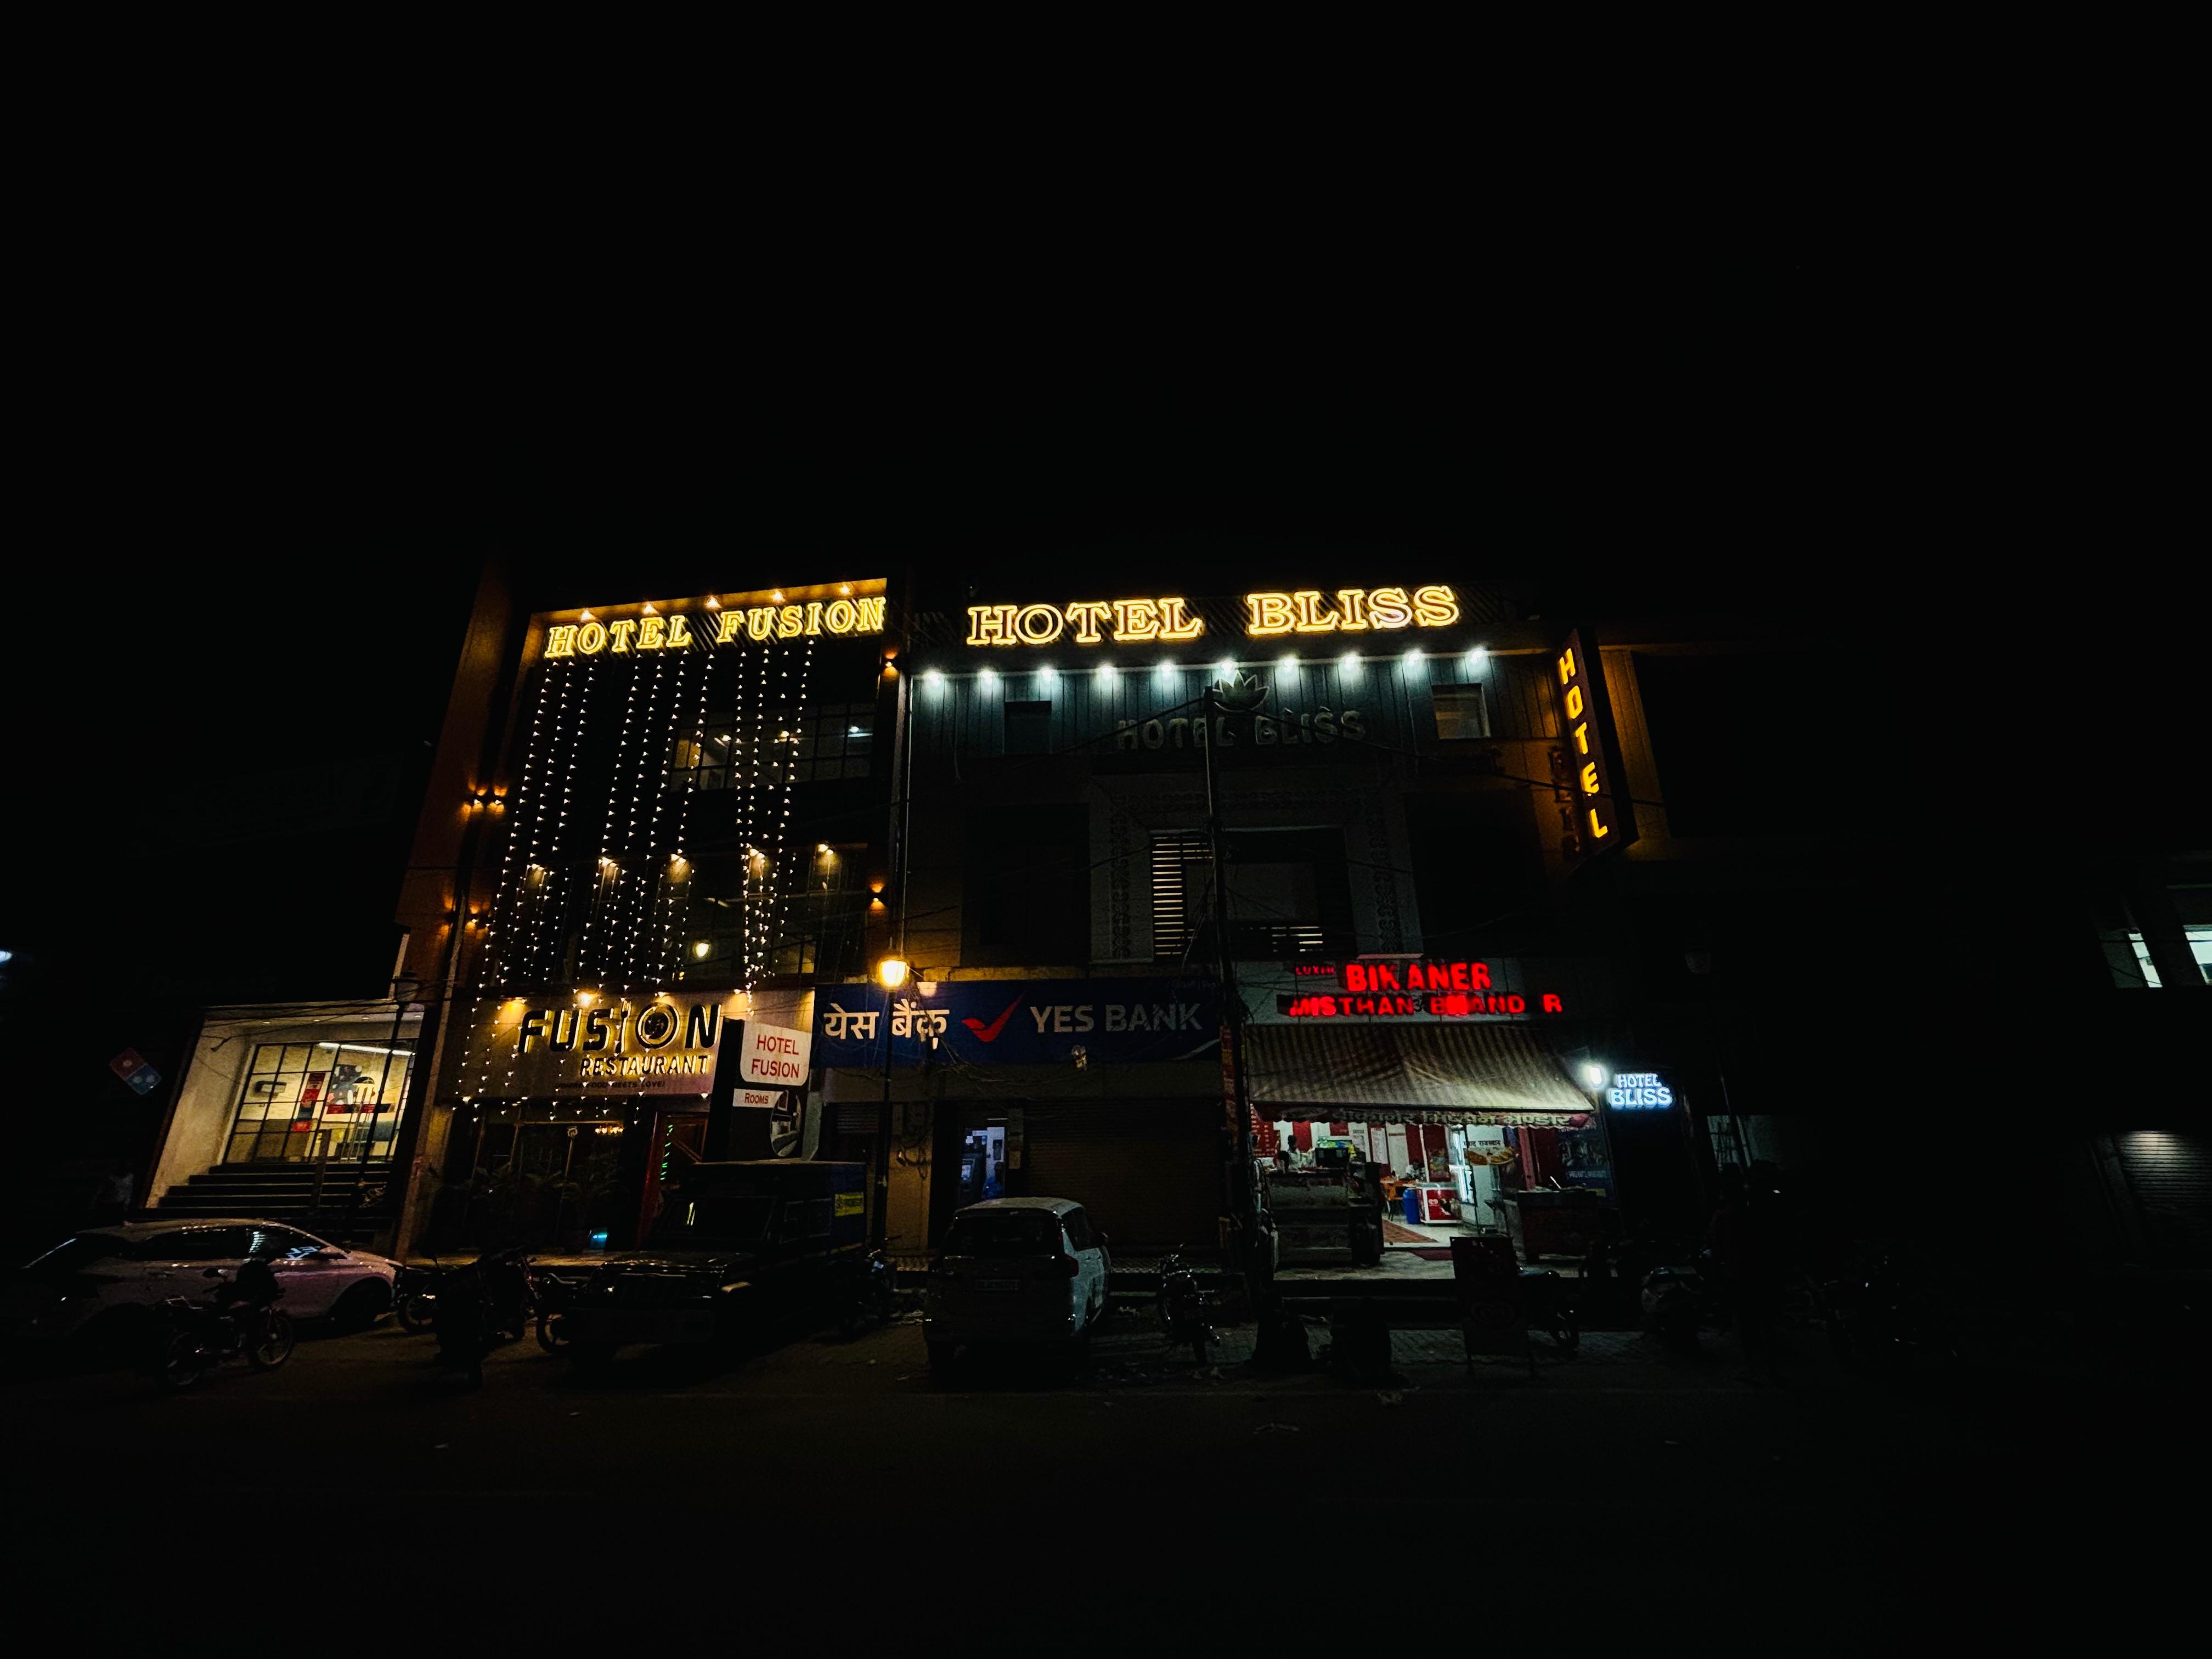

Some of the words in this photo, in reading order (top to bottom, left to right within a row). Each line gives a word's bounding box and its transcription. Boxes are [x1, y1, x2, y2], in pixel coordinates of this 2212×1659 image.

[545, 615, 692, 659] HOTEL
[716, 597, 887, 644] FUSION
[966, 597, 1203, 646] HOTEL
[1247, 585, 1460, 636] BLISS
[1116, 715, 1235, 751] HOTEL
[1255, 709, 1367, 746] BLISS
[1558, 647, 1609, 838] HOTEL
[1345, 962, 1492, 992] BIKANER
[517, 1000, 721, 1053] FUSION
[823, 1003, 879, 1040] येस
[1029, 1005, 1094, 1034] YES
[1105, 1002, 1203, 1032] BANK
[757, 1034, 799, 1056] HOTEL
[580, 1054, 711, 1076] RESTAURANT
[751, 1058, 800, 1079] FUSION
[1615, 1073, 1662, 1088] HOTEL
[744, 1092, 769, 1104] ROOMS
[1608, 1087, 1675, 1109] BLISS
